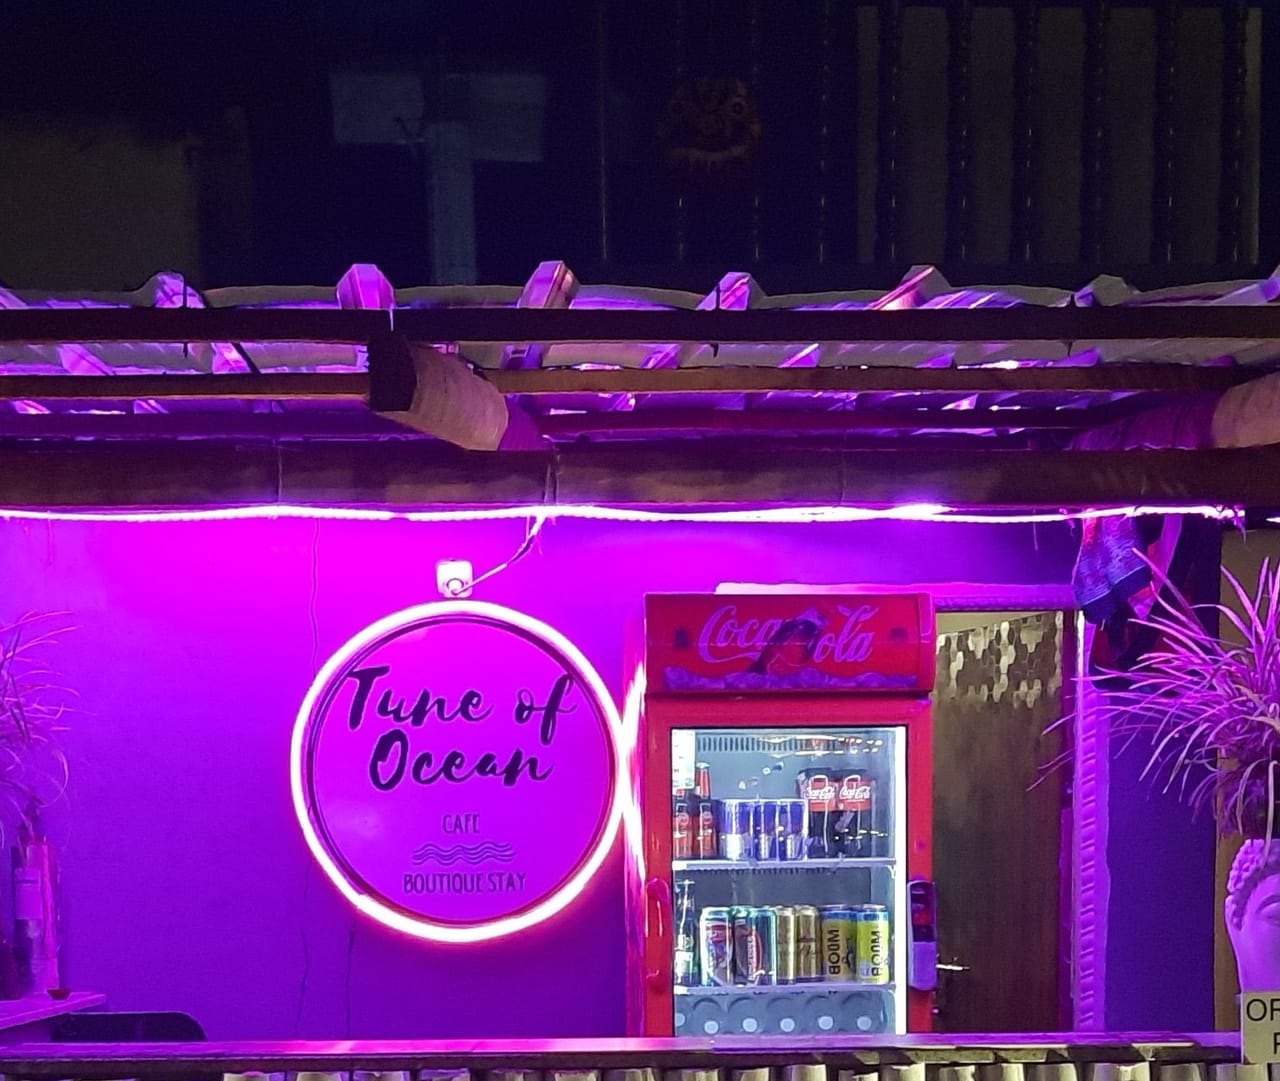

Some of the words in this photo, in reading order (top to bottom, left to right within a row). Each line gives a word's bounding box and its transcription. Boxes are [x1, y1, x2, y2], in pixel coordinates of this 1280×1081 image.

[347, 665, 494, 730] Tune
[515, 673, 577, 745] of
[370, 729, 553, 791] Ocean
[443, 814, 479, 833] CAFE
[404, 873, 483, 893] BOUTIQUE
[488, 872, 525, 892] STAY
